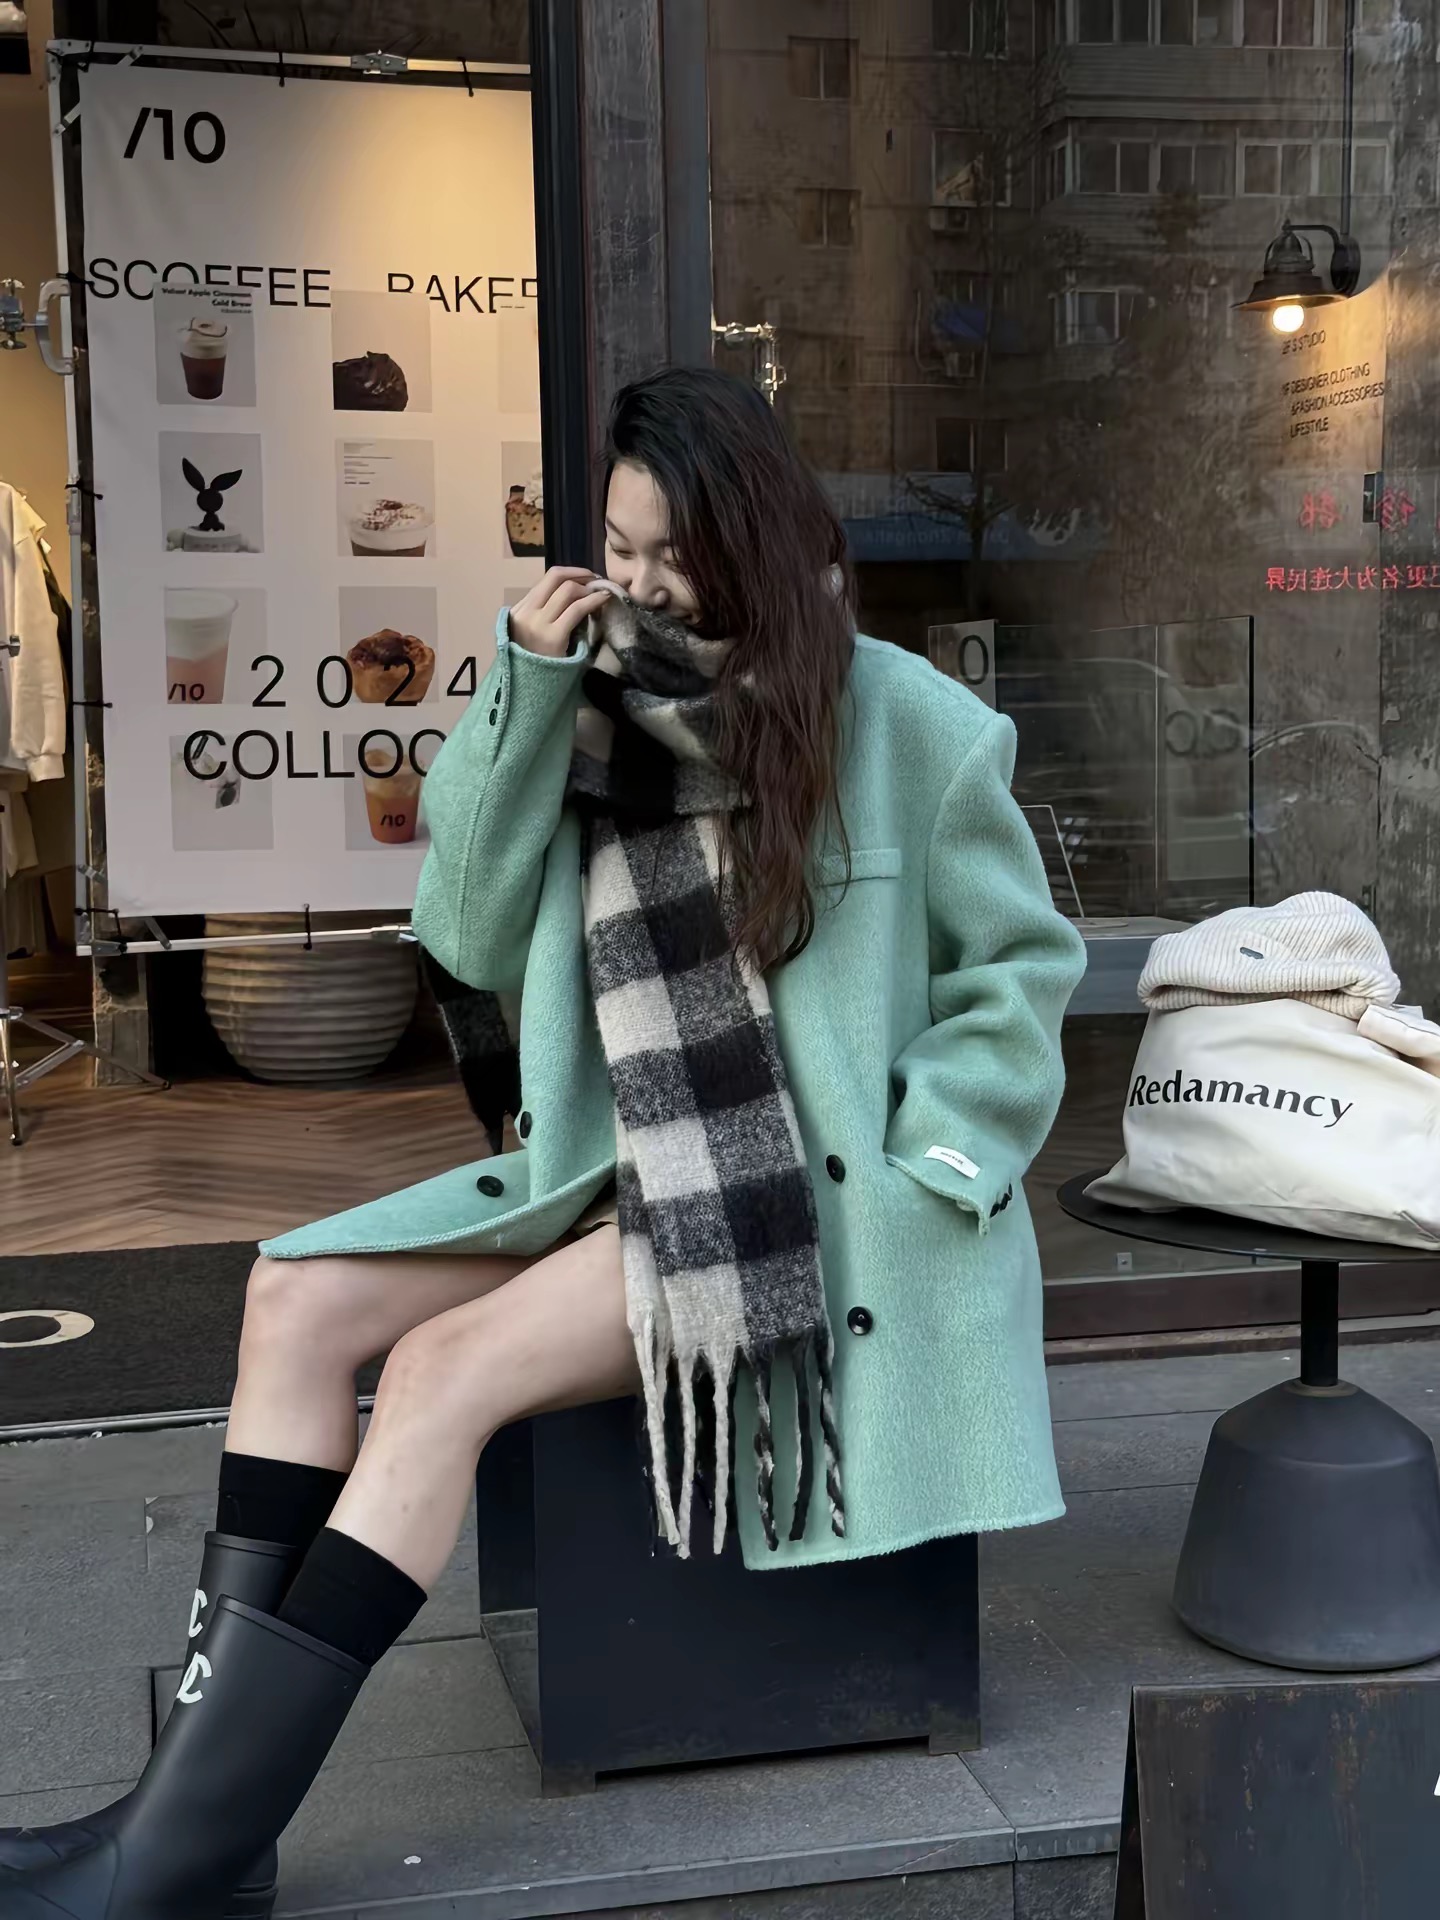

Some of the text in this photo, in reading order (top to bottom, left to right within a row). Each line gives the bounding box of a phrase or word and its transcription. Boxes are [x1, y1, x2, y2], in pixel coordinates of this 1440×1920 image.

[123, 107, 226, 164] /10
[1330, 362, 1370, 384] CLOTHING
[1290, 417, 1329, 438] LIFESTYLE
[1128, 1069, 1354, 1128] Redamancy
